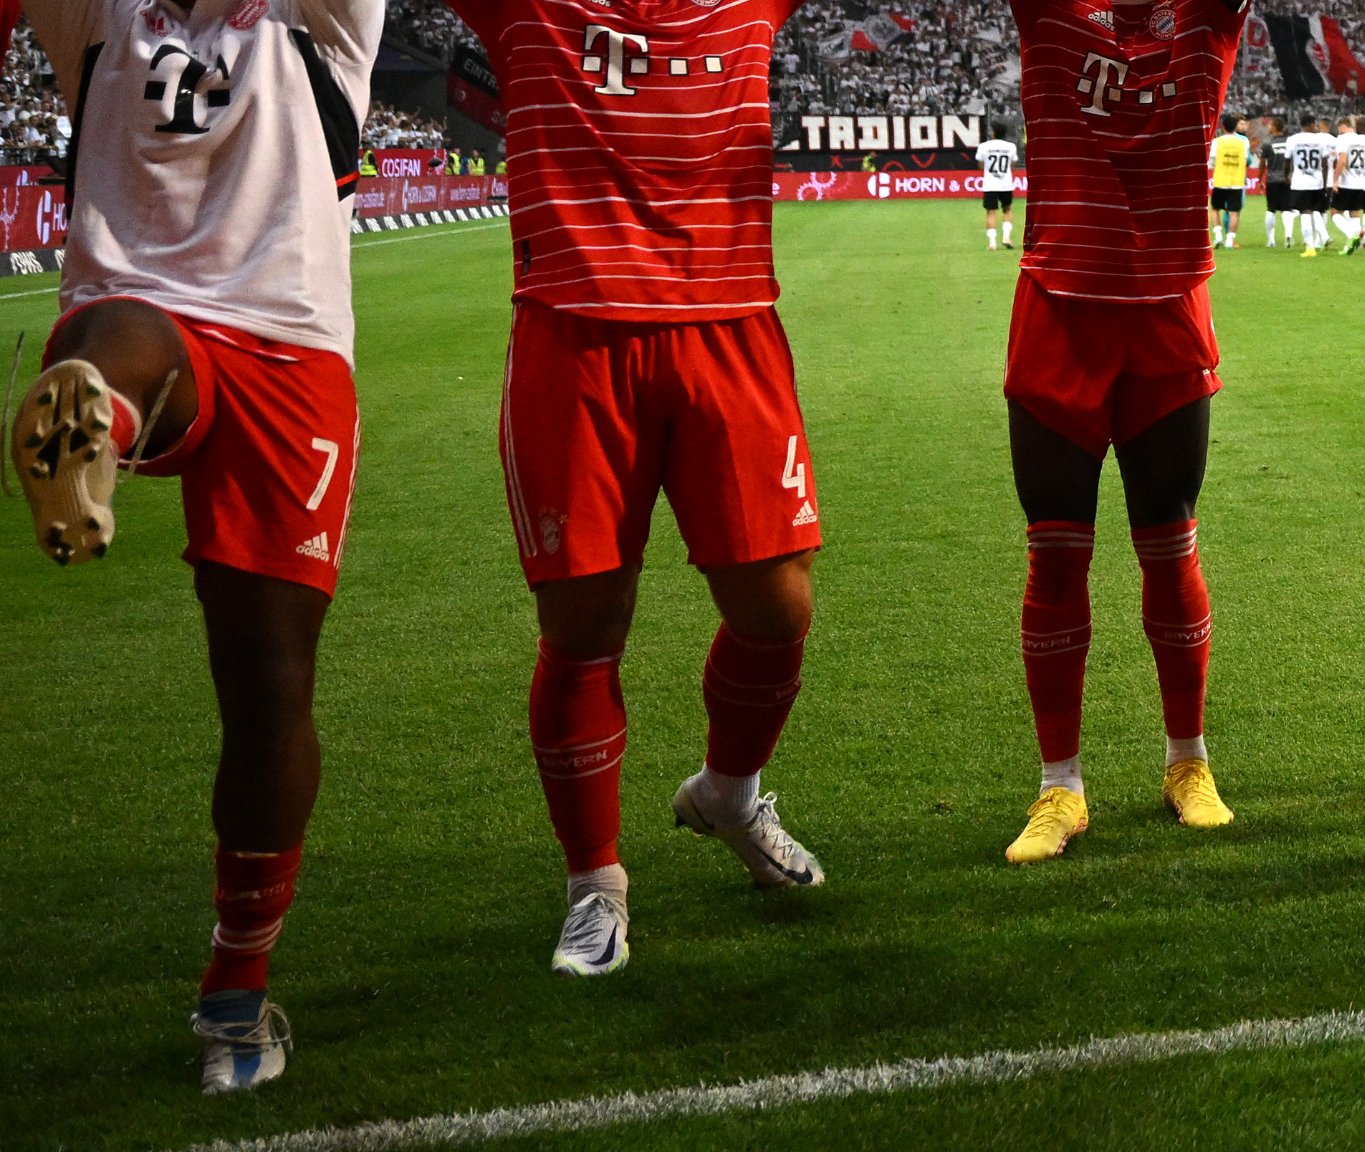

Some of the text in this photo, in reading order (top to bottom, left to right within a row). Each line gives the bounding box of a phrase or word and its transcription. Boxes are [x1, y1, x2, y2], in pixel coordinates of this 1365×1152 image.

[1087, 12, 1116, 32] adidas
[582, 24, 649, 96] T
[464, 58, 497, 88] EINTR
[1077, 51, 1129, 118] T
[144, 44, 230, 134] T
[802, 115, 982, 150] TADION
[382, 158, 421, 178] COSIFAN
[988, 154, 1009, 173] 20
[1296, 149, 1320, 170] 36
[896, 176, 946, 193] HORN
[949, 177, 960, 193] &
[306, 437, 339, 510] 7
[781, 434, 806, 499] 4
[792, 514, 818, 527] adidas
[295, 543, 330, 562] adidas
